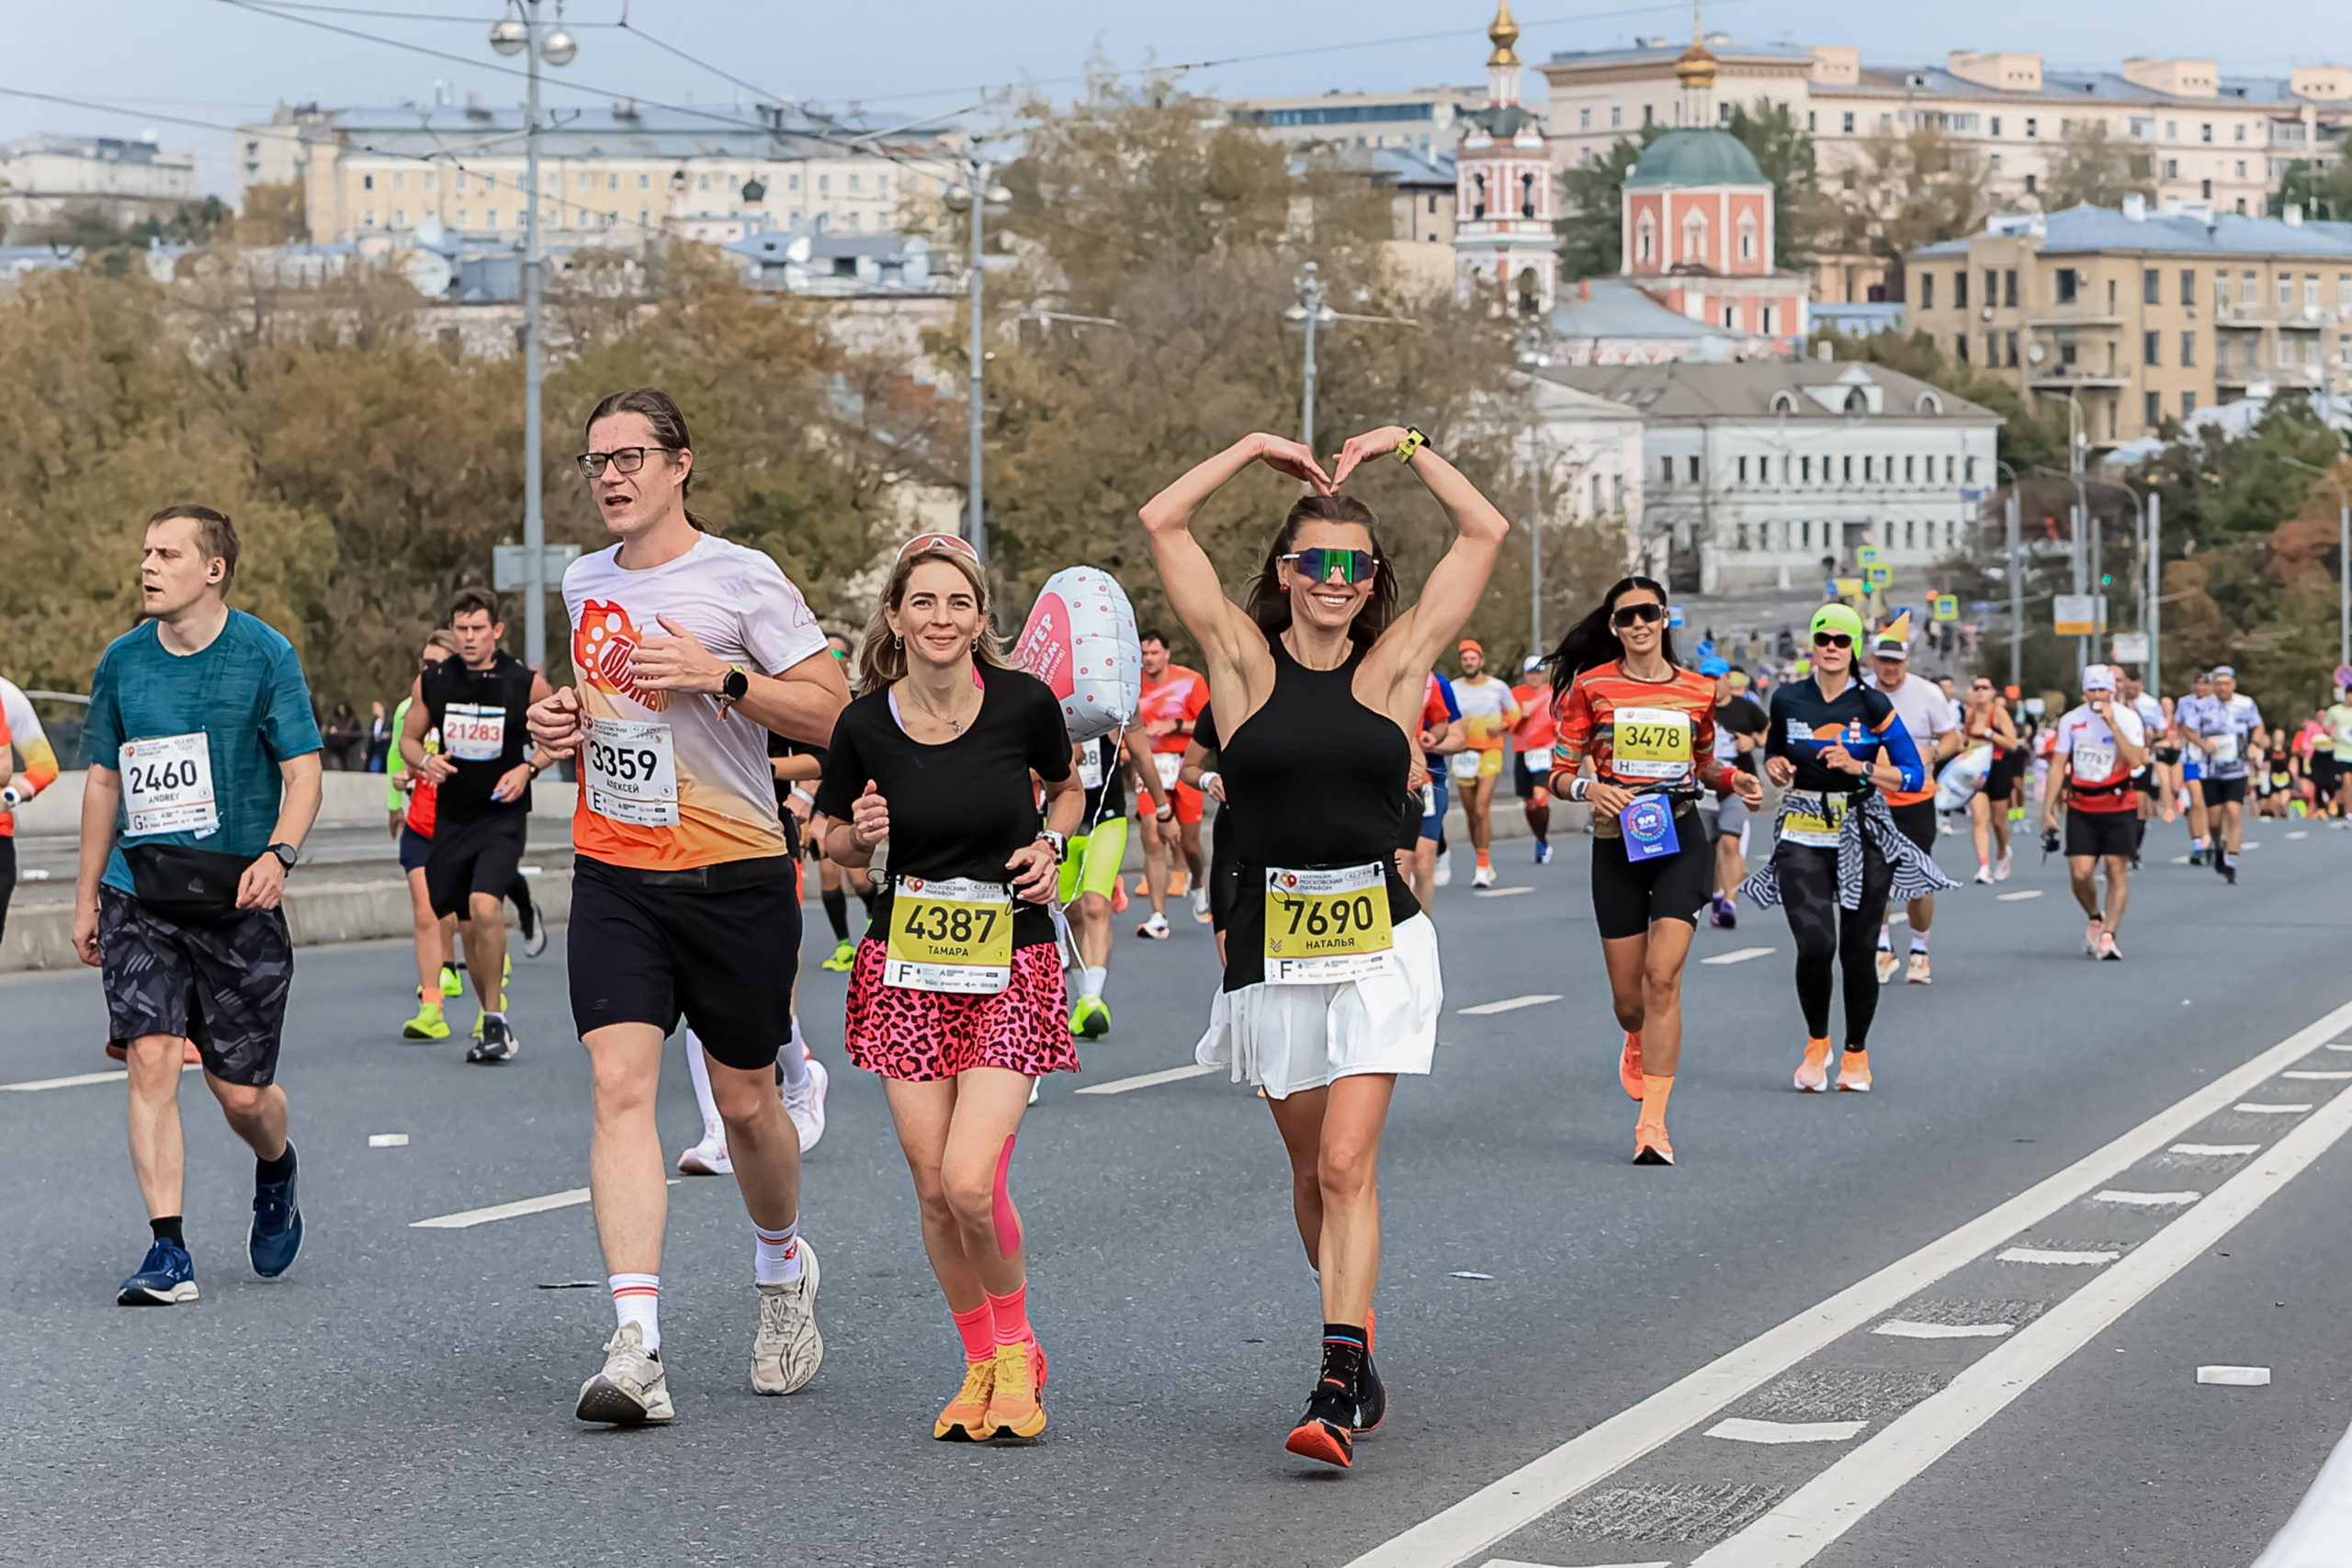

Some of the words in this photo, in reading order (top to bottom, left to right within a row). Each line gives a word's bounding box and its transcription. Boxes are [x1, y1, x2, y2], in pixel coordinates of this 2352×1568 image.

[447, 721, 501, 742] 21283
[1625, 726, 1680, 749] 3478
[590, 740, 657, 781] 3359
[130, 759, 198, 795] 2460
[606, 779, 639, 794] АЛЕКСЕЙ
[148, 792, 181, 804] ANDREY
[133, 815, 144, 831] G
[925, 884, 967, 892] МОСКОВСКИЙ
[905, 905, 997, 943] 4387
[1283, 896, 1374, 936] 7690
[928, 945, 969, 957] ТАМАРА
[1306, 938, 1355, 950] НАТАЛЬЯ
[899, 964, 913, 983] F
[1281, 961, 1294, 979] F
